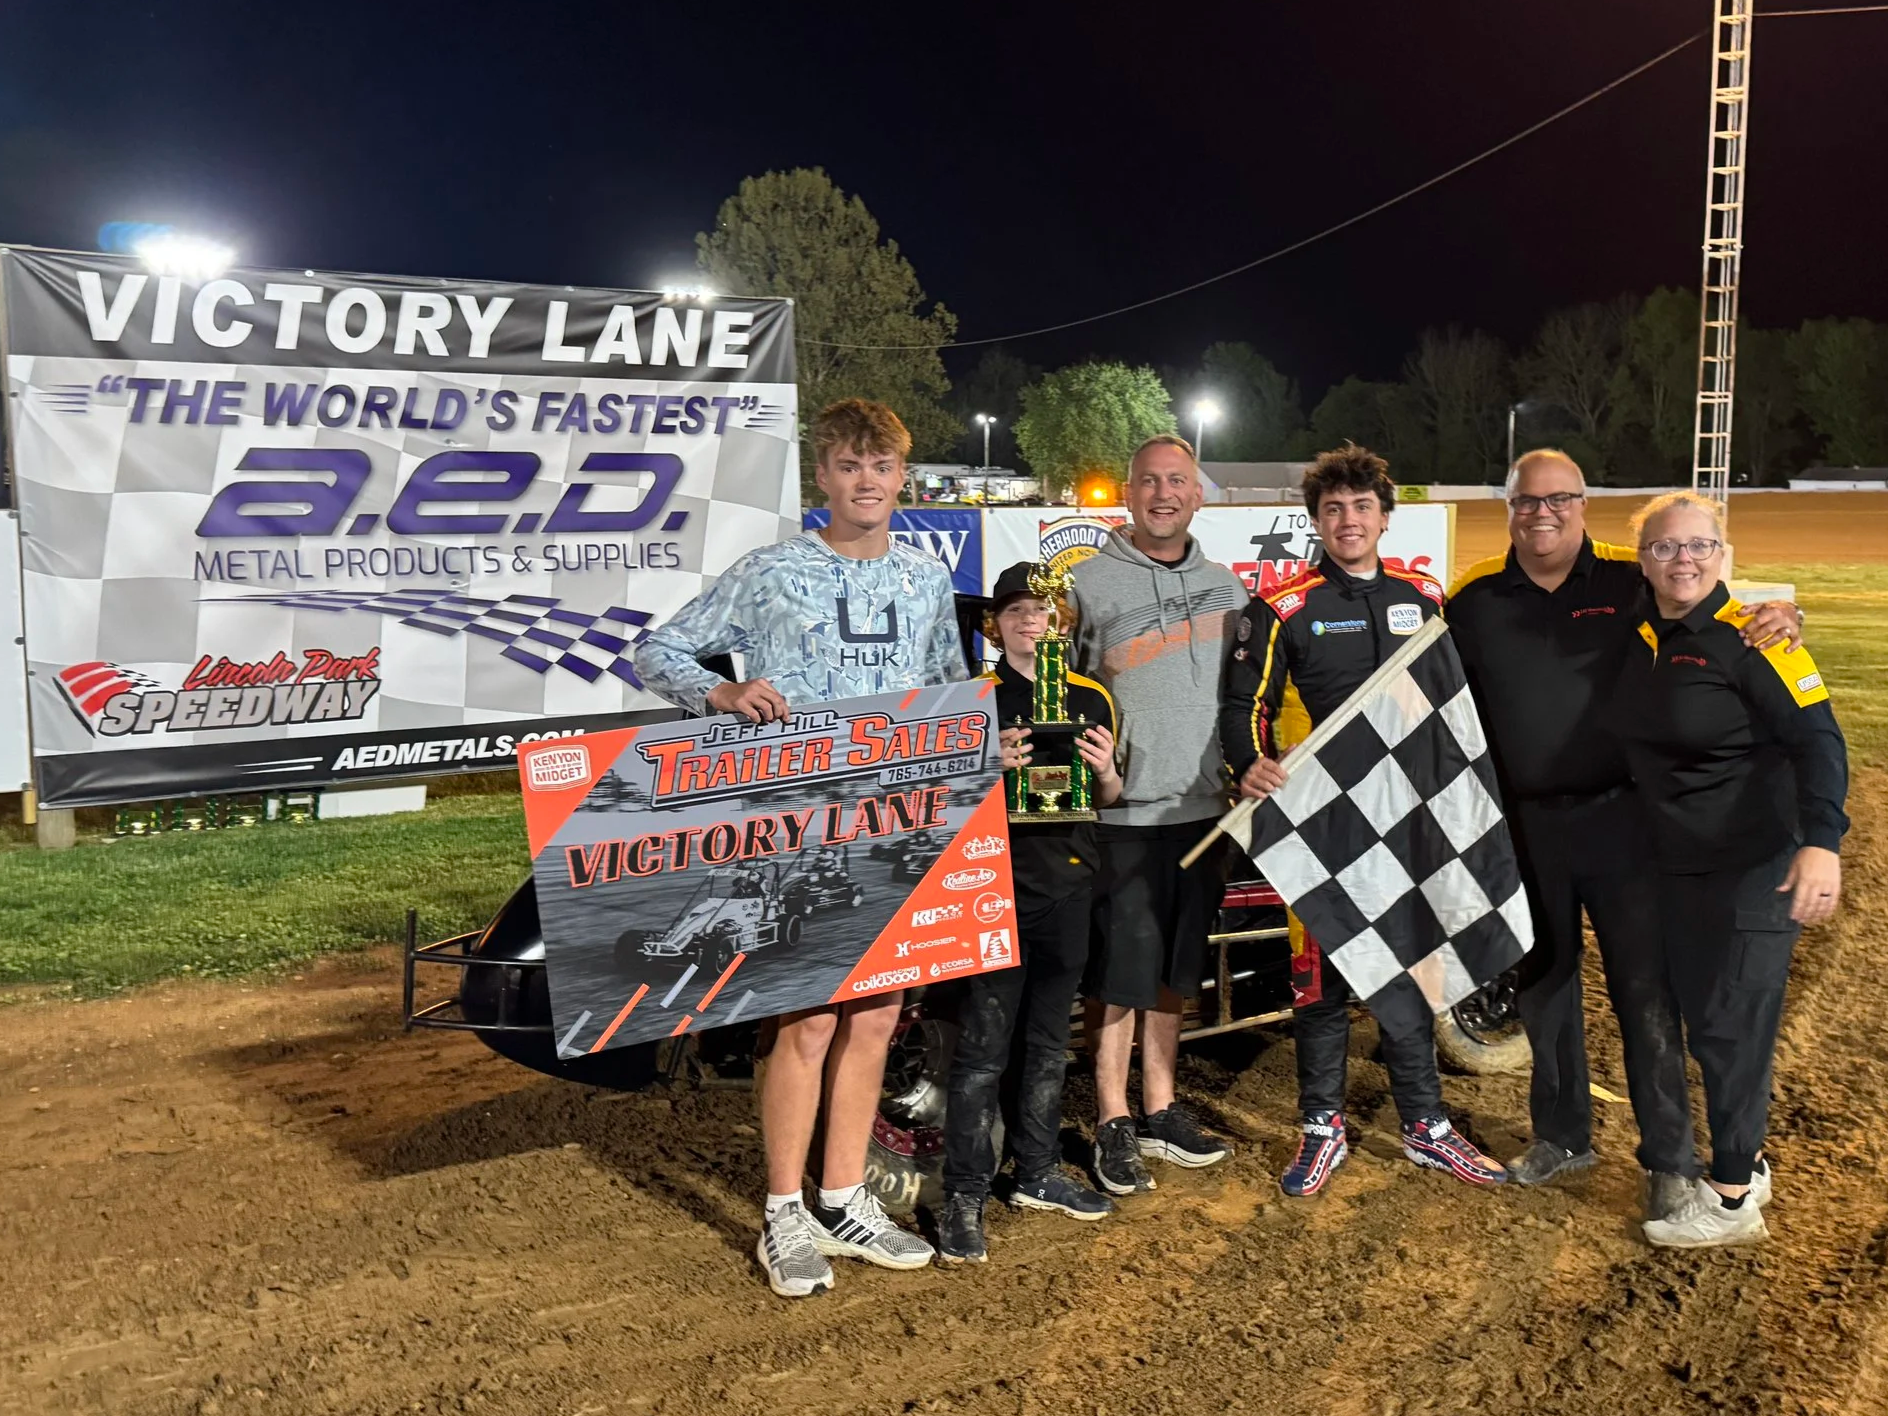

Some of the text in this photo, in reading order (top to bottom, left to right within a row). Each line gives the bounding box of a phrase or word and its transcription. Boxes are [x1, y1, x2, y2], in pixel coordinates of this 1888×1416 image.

[77, 271, 755, 369] VICTORY LANE
[1288, 514, 1312, 529] TO
[1041, 528, 1096, 560] HERHOOD
[195, 542, 680, 582] METAL PRODUCTS & SUPPLIES
[183, 647, 380, 691] Lincoln Park
[98, 679, 381, 737] SPEEDWAY
[702, 713, 836, 744] JEFF HILL
[848, 714, 985, 766] SALES
[533, 752, 581, 767] KENYON
[535, 766, 583, 782] MIDGET
[888, 757, 976, 783] 765-744-6214
[565, 786, 951, 888] VICTORY LANE
[911, 937, 957, 950] HOOSIER
